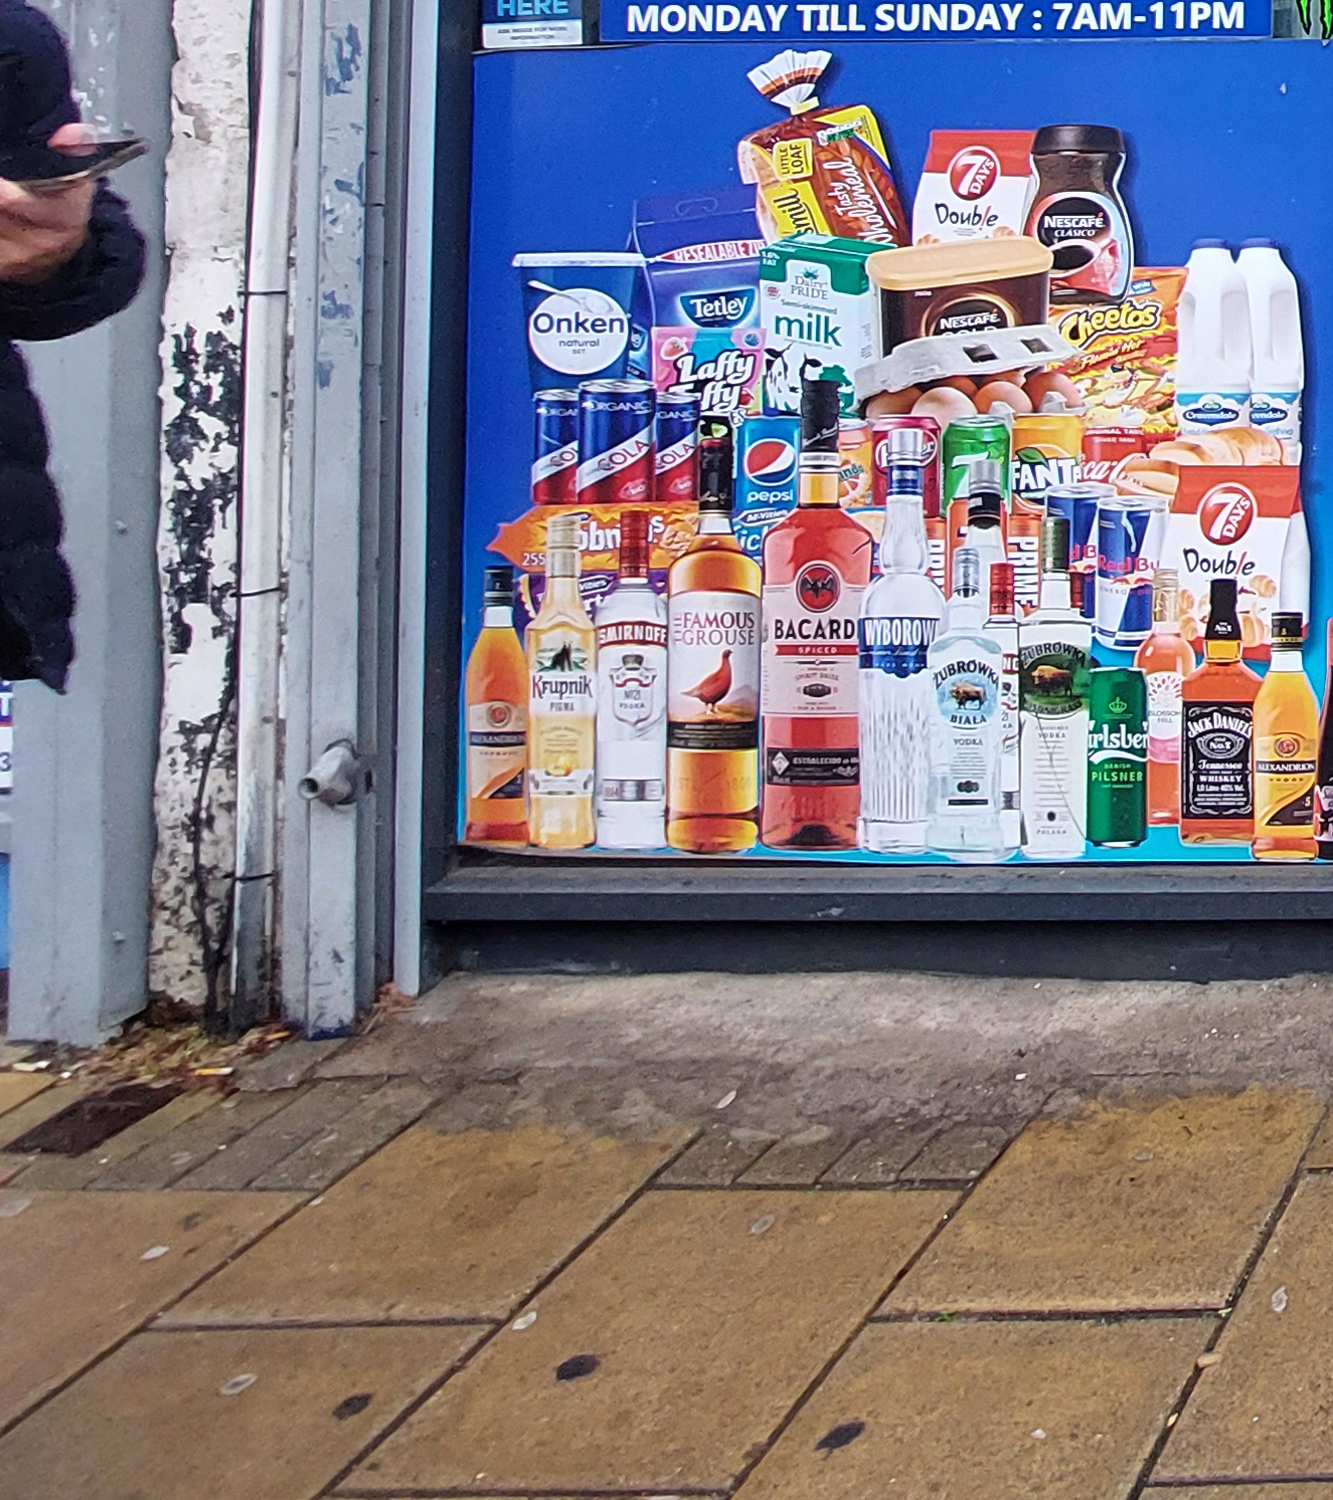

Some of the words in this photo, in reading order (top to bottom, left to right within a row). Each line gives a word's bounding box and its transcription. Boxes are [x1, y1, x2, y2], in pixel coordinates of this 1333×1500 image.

[627, 4, 789, 33] MONDAY
[795, 3, 866, 32] TILL
[874, 3, 1024, 32] SUNDAY
[1053, 0, 1245, 32] 7AM-11PM
[779, 147, 791, 175] LITTLE
[789, 143, 804, 175] LOAF
[958, 154, 987, 196] 7
[969, 158, 996, 195] DAYS
[827, 182, 851, 216] Tasty
[934, 202, 999, 231] Double
[1043, 211, 1106, 229] NESCAFÉ
[689, 295, 749, 319] Tetley
[790, 286, 829, 300] PRIDE
[533, 311, 626, 335] Onken
[774, 312, 842, 348] milk
[1062, 302, 1158, 344] Cheetos
[558, 337, 600, 348] natural
[675, 350, 755, 385] Laffy
[599, 440, 650, 470] COLA
[746, 488, 794, 503] pepsi
[1208, 493, 1236, 539] 7
[1222, 496, 1252, 538] DAYS
[1013, 536, 1039, 607] PRIME
[1096, 554, 1131, 572] Red
[1182, 547, 1256, 580] Double
[599, 622, 668, 645] SMIRNOFF
[683, 612, 755, 630] FAMOUS
[774, 617, 857, 640] BACARD
[683, 629, 755, 646] GROUSE
[532, 675, 593, 700] Krupnik
[1091, 770, 1143, 783] PILSNER
